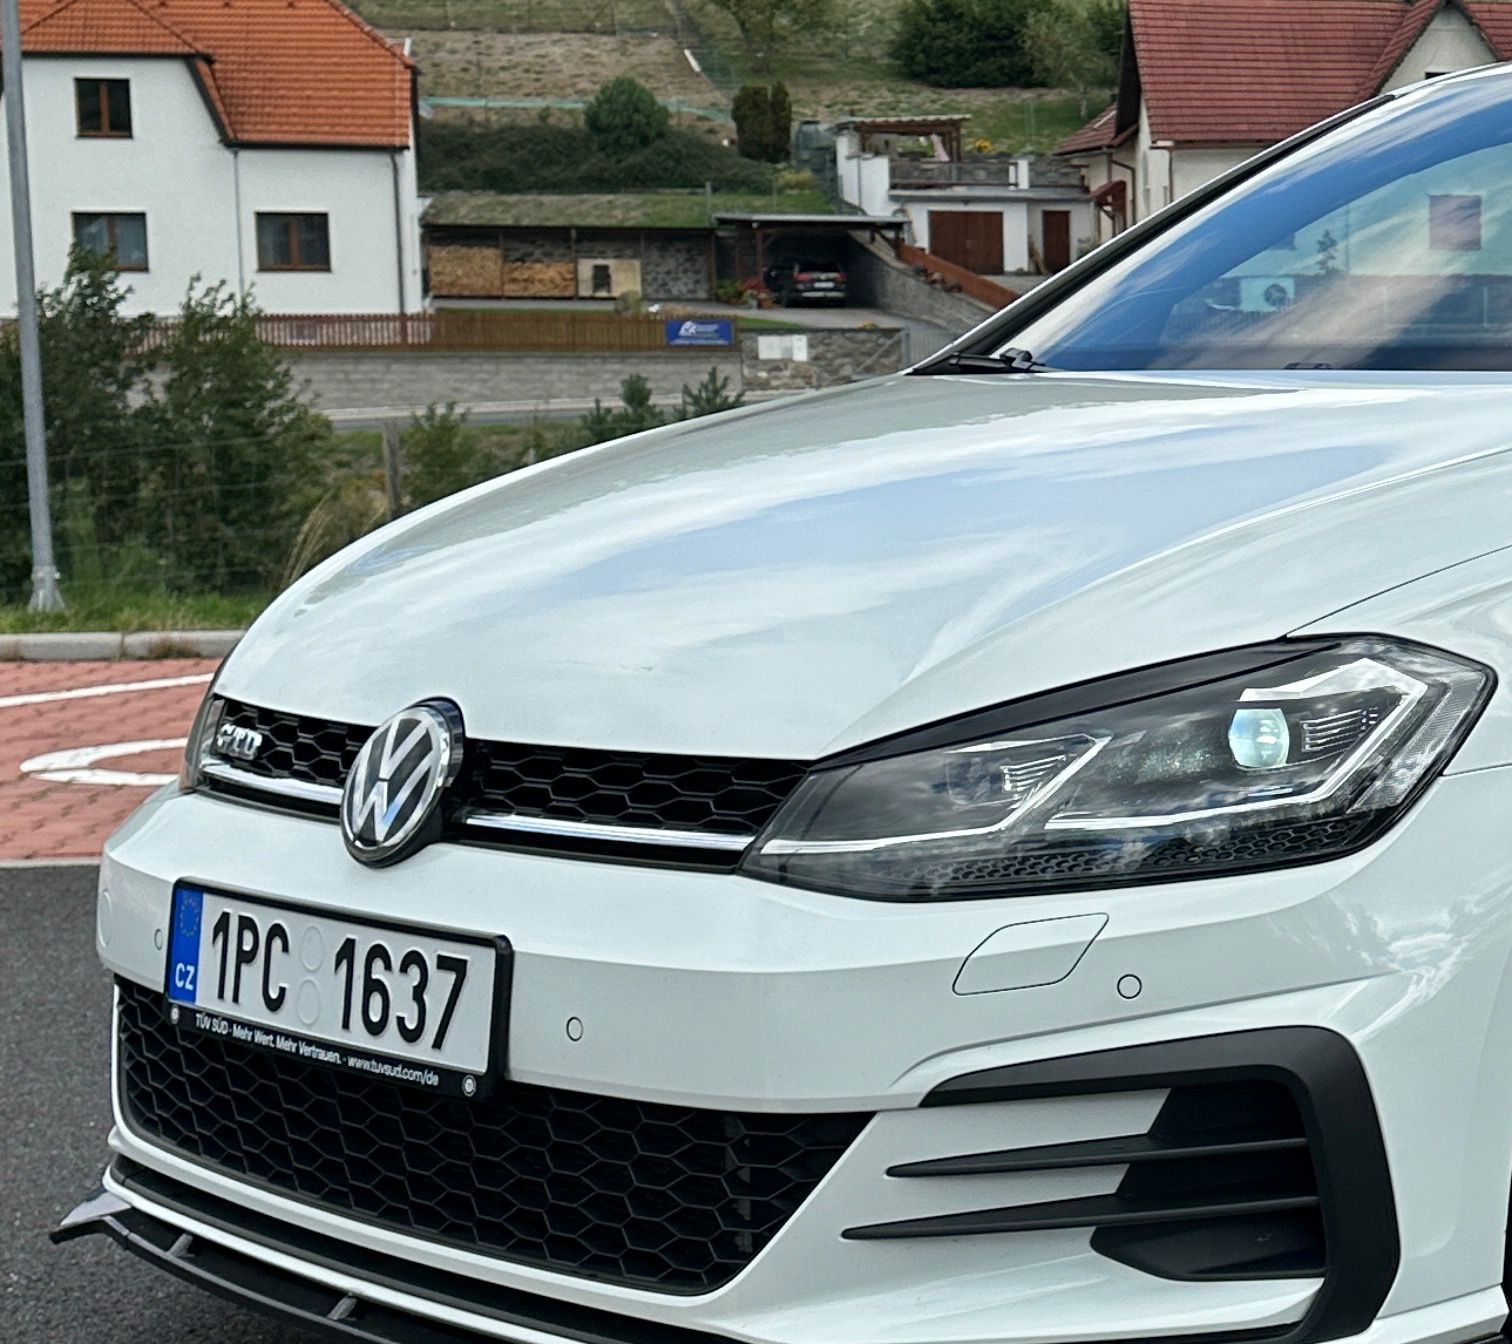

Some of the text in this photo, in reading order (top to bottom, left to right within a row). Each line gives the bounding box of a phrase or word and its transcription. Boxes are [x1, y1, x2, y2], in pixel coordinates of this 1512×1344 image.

[174, 962, 195, 991] CZ
[212, 910, 469, 1051] 1PC 1637
[195, 1012, 440, 1087] TÜV SÜD Mehr Wert. Mehr Vertrauen. www.tuvsud.com/de
